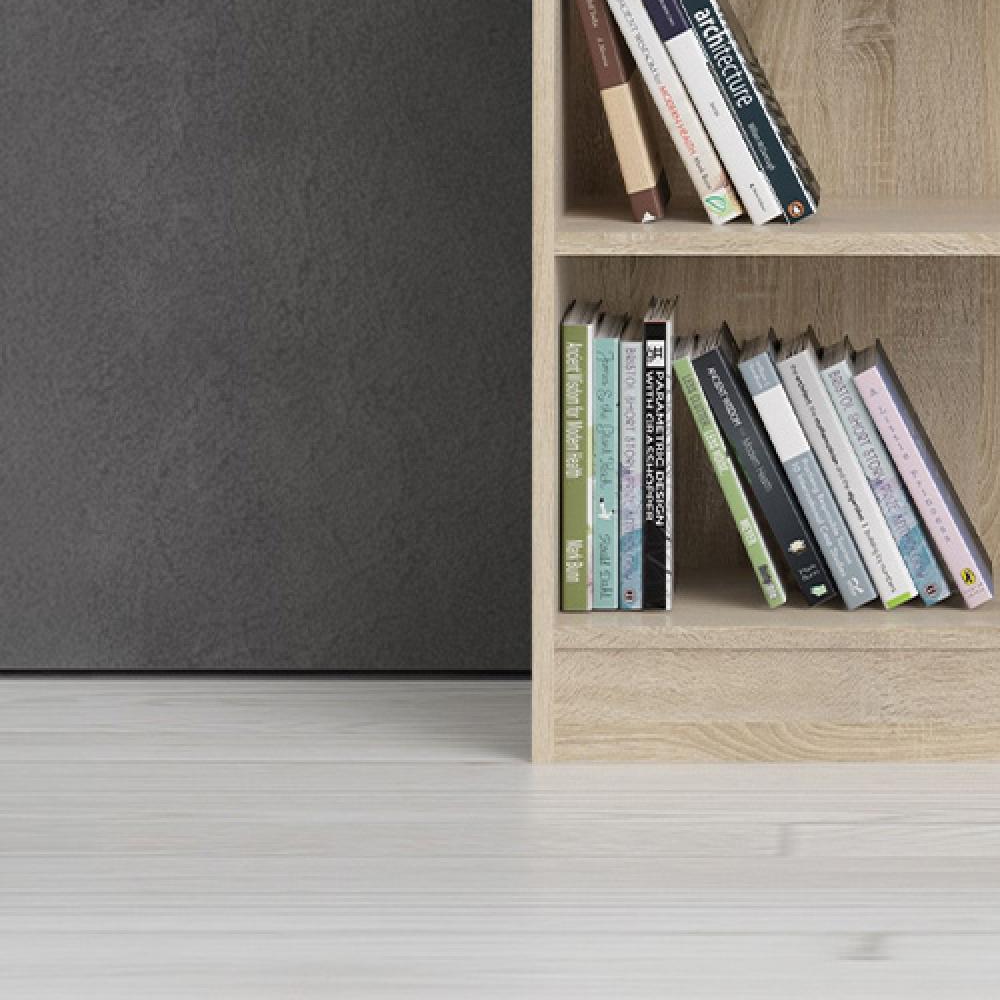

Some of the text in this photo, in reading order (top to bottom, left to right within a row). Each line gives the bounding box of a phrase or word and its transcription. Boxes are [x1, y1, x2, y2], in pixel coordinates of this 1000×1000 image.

[695, 6, 753, 107] architecture
[645, 371, 654, 408] WITH
[655, 371, 664, 526] PARAMETRIC DESIGN
